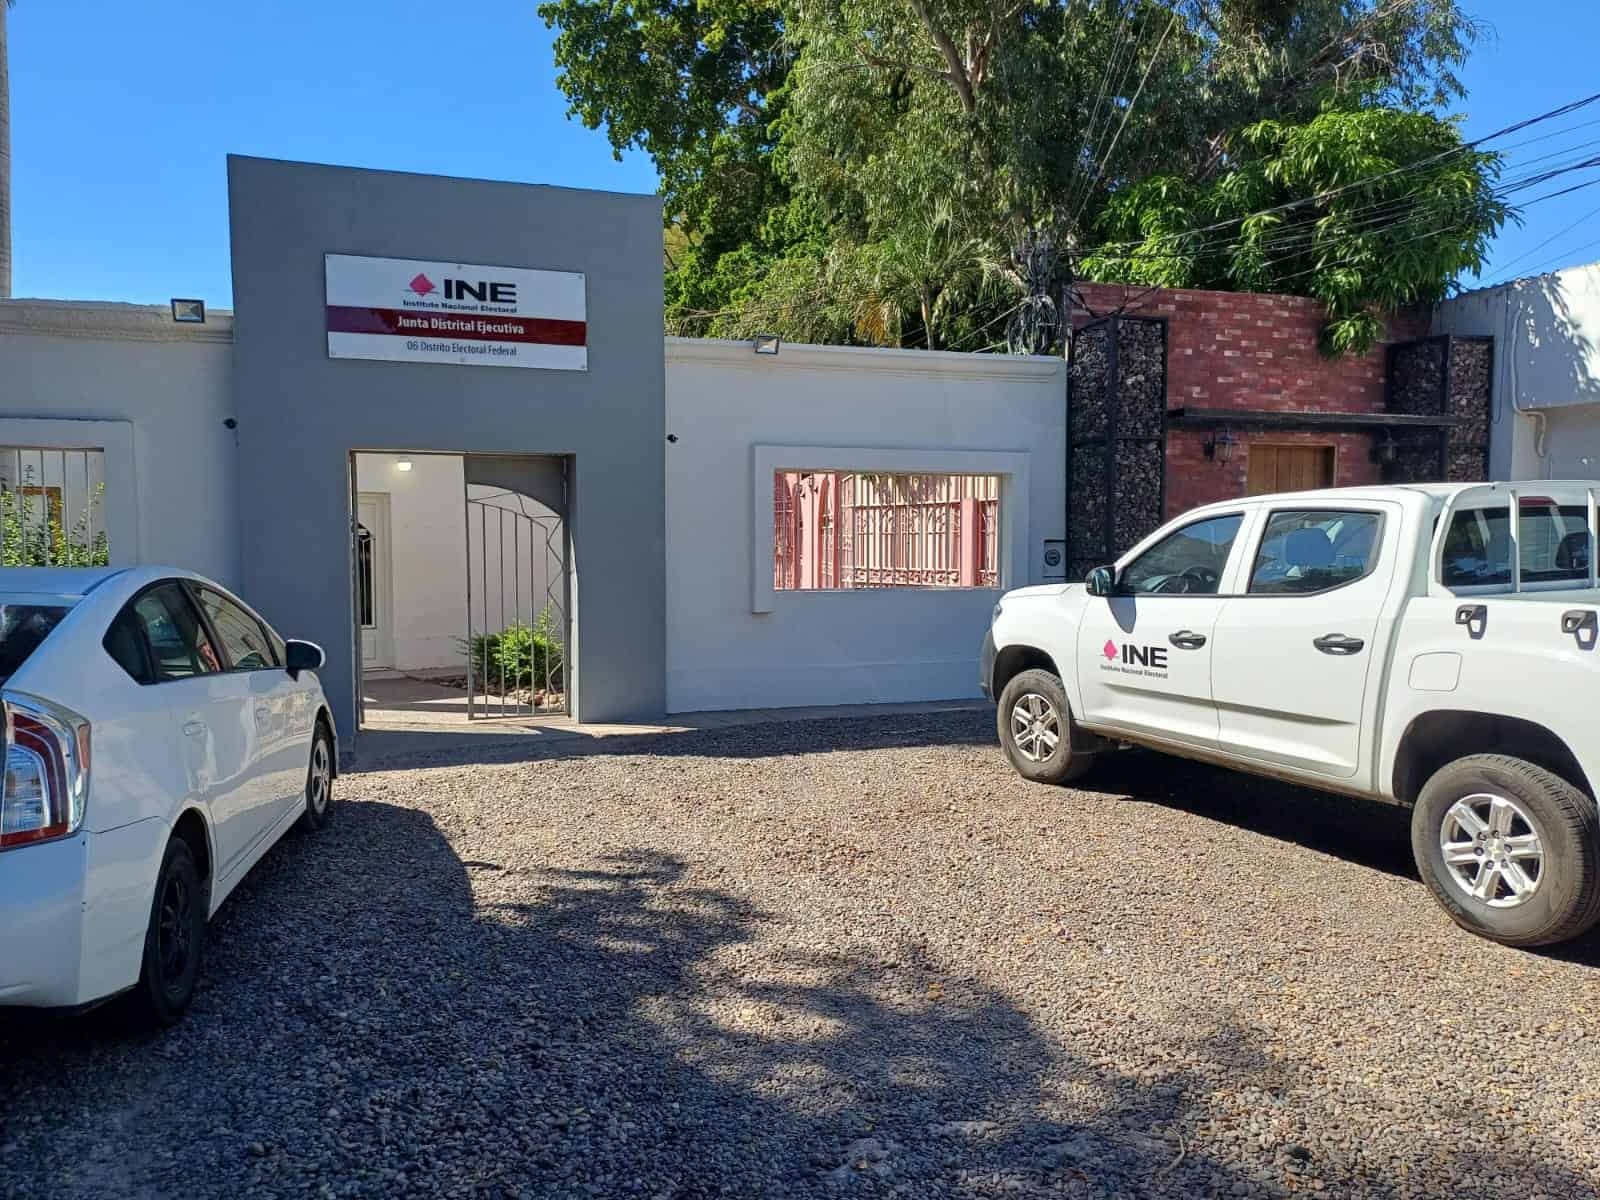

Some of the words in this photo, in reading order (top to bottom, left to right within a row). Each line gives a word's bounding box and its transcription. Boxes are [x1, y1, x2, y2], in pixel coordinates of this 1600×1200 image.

[444, 279, 517, 304] INE
[403, 300, 439, 309] Instituto
[441, 303, 478, 312] Nacional
[481, 304, 517, 313] Electoral
[398, 316, 428, 329] Junta
[431, 318, 474, 332] Distrital
[478, 321, 525, 335] Ejecutiva
[406, 340, 418, 351] 06
[420, 341, 450, 353] Distrito
[452, 343, 486, 355] Electoral
[488, 345, 517, 356] Federal
[1122, 644, 1168, 668] INE
